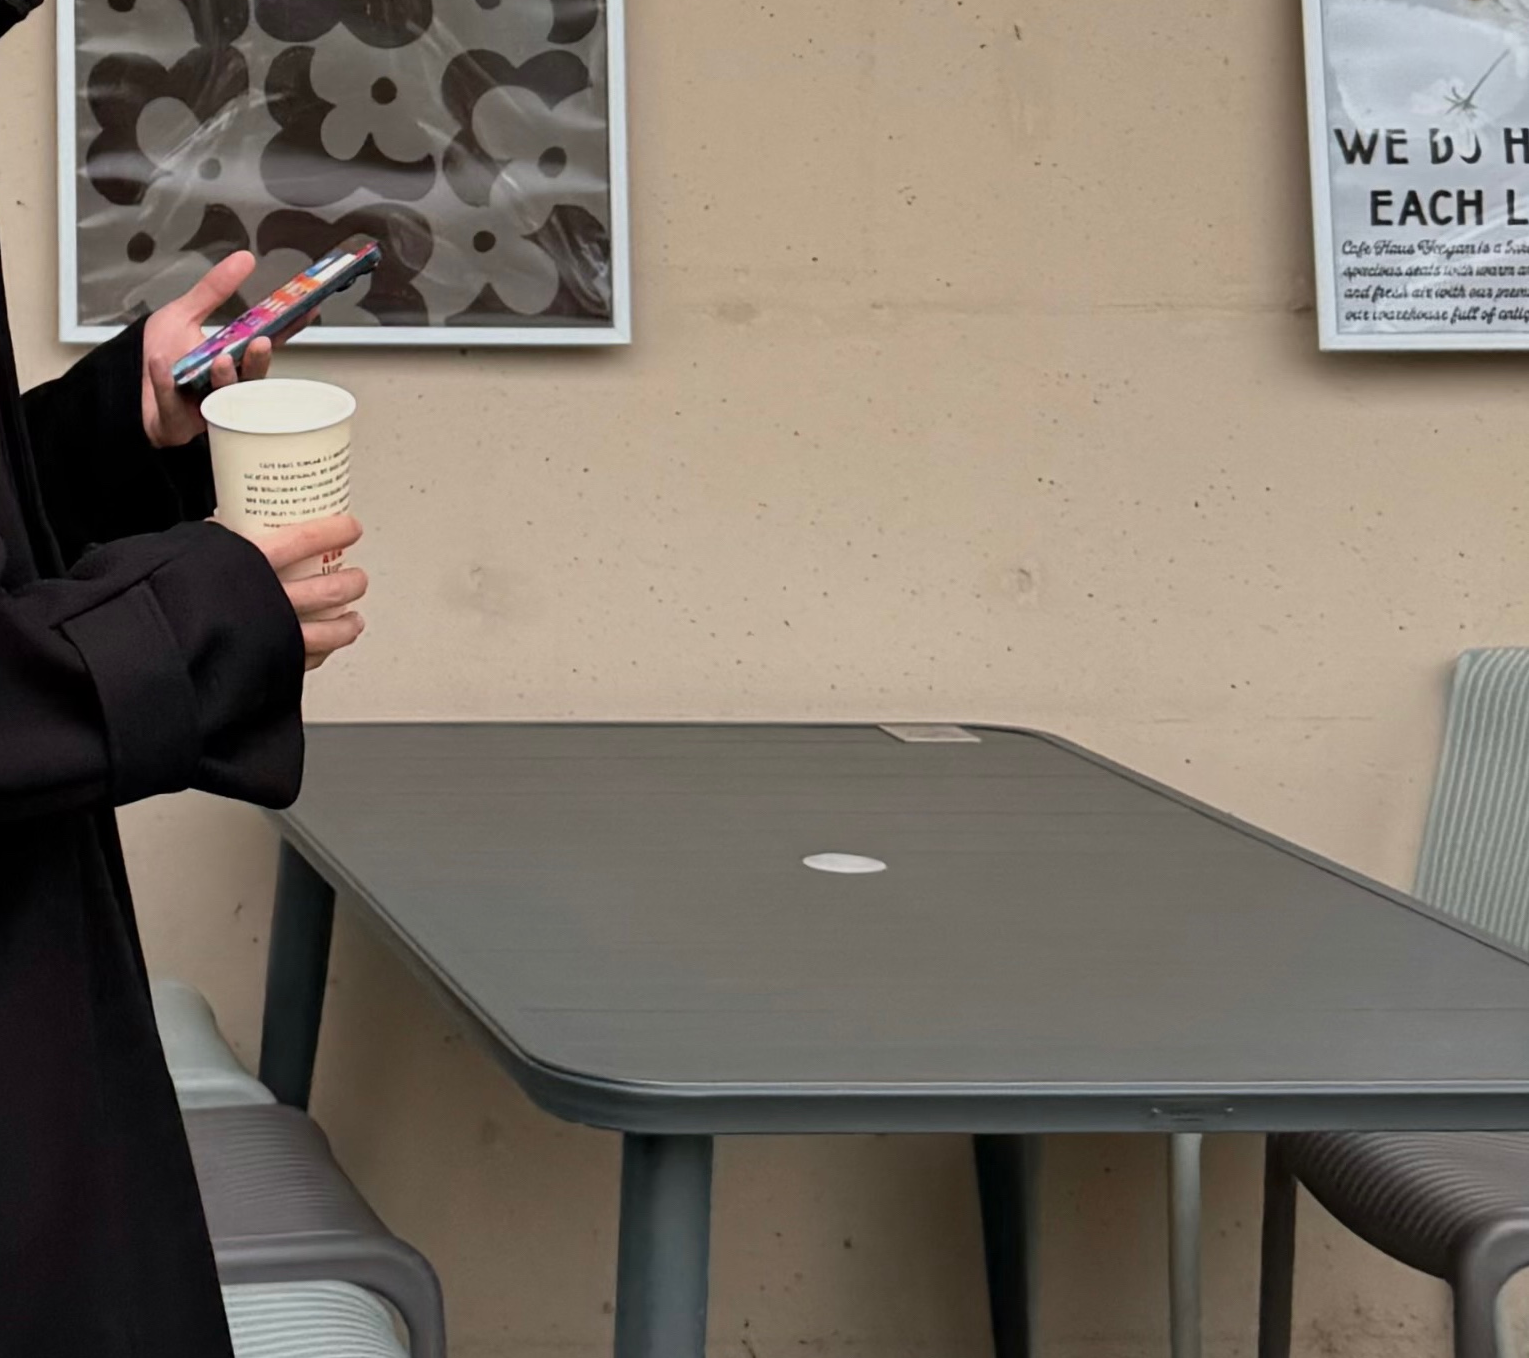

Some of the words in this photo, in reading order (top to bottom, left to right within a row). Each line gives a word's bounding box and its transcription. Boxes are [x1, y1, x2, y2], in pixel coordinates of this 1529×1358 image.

[1333, 128, 1409, 165] WE
[1370, 190, 1483, 226] EACH
[1481, 306, 1497, 325] of
